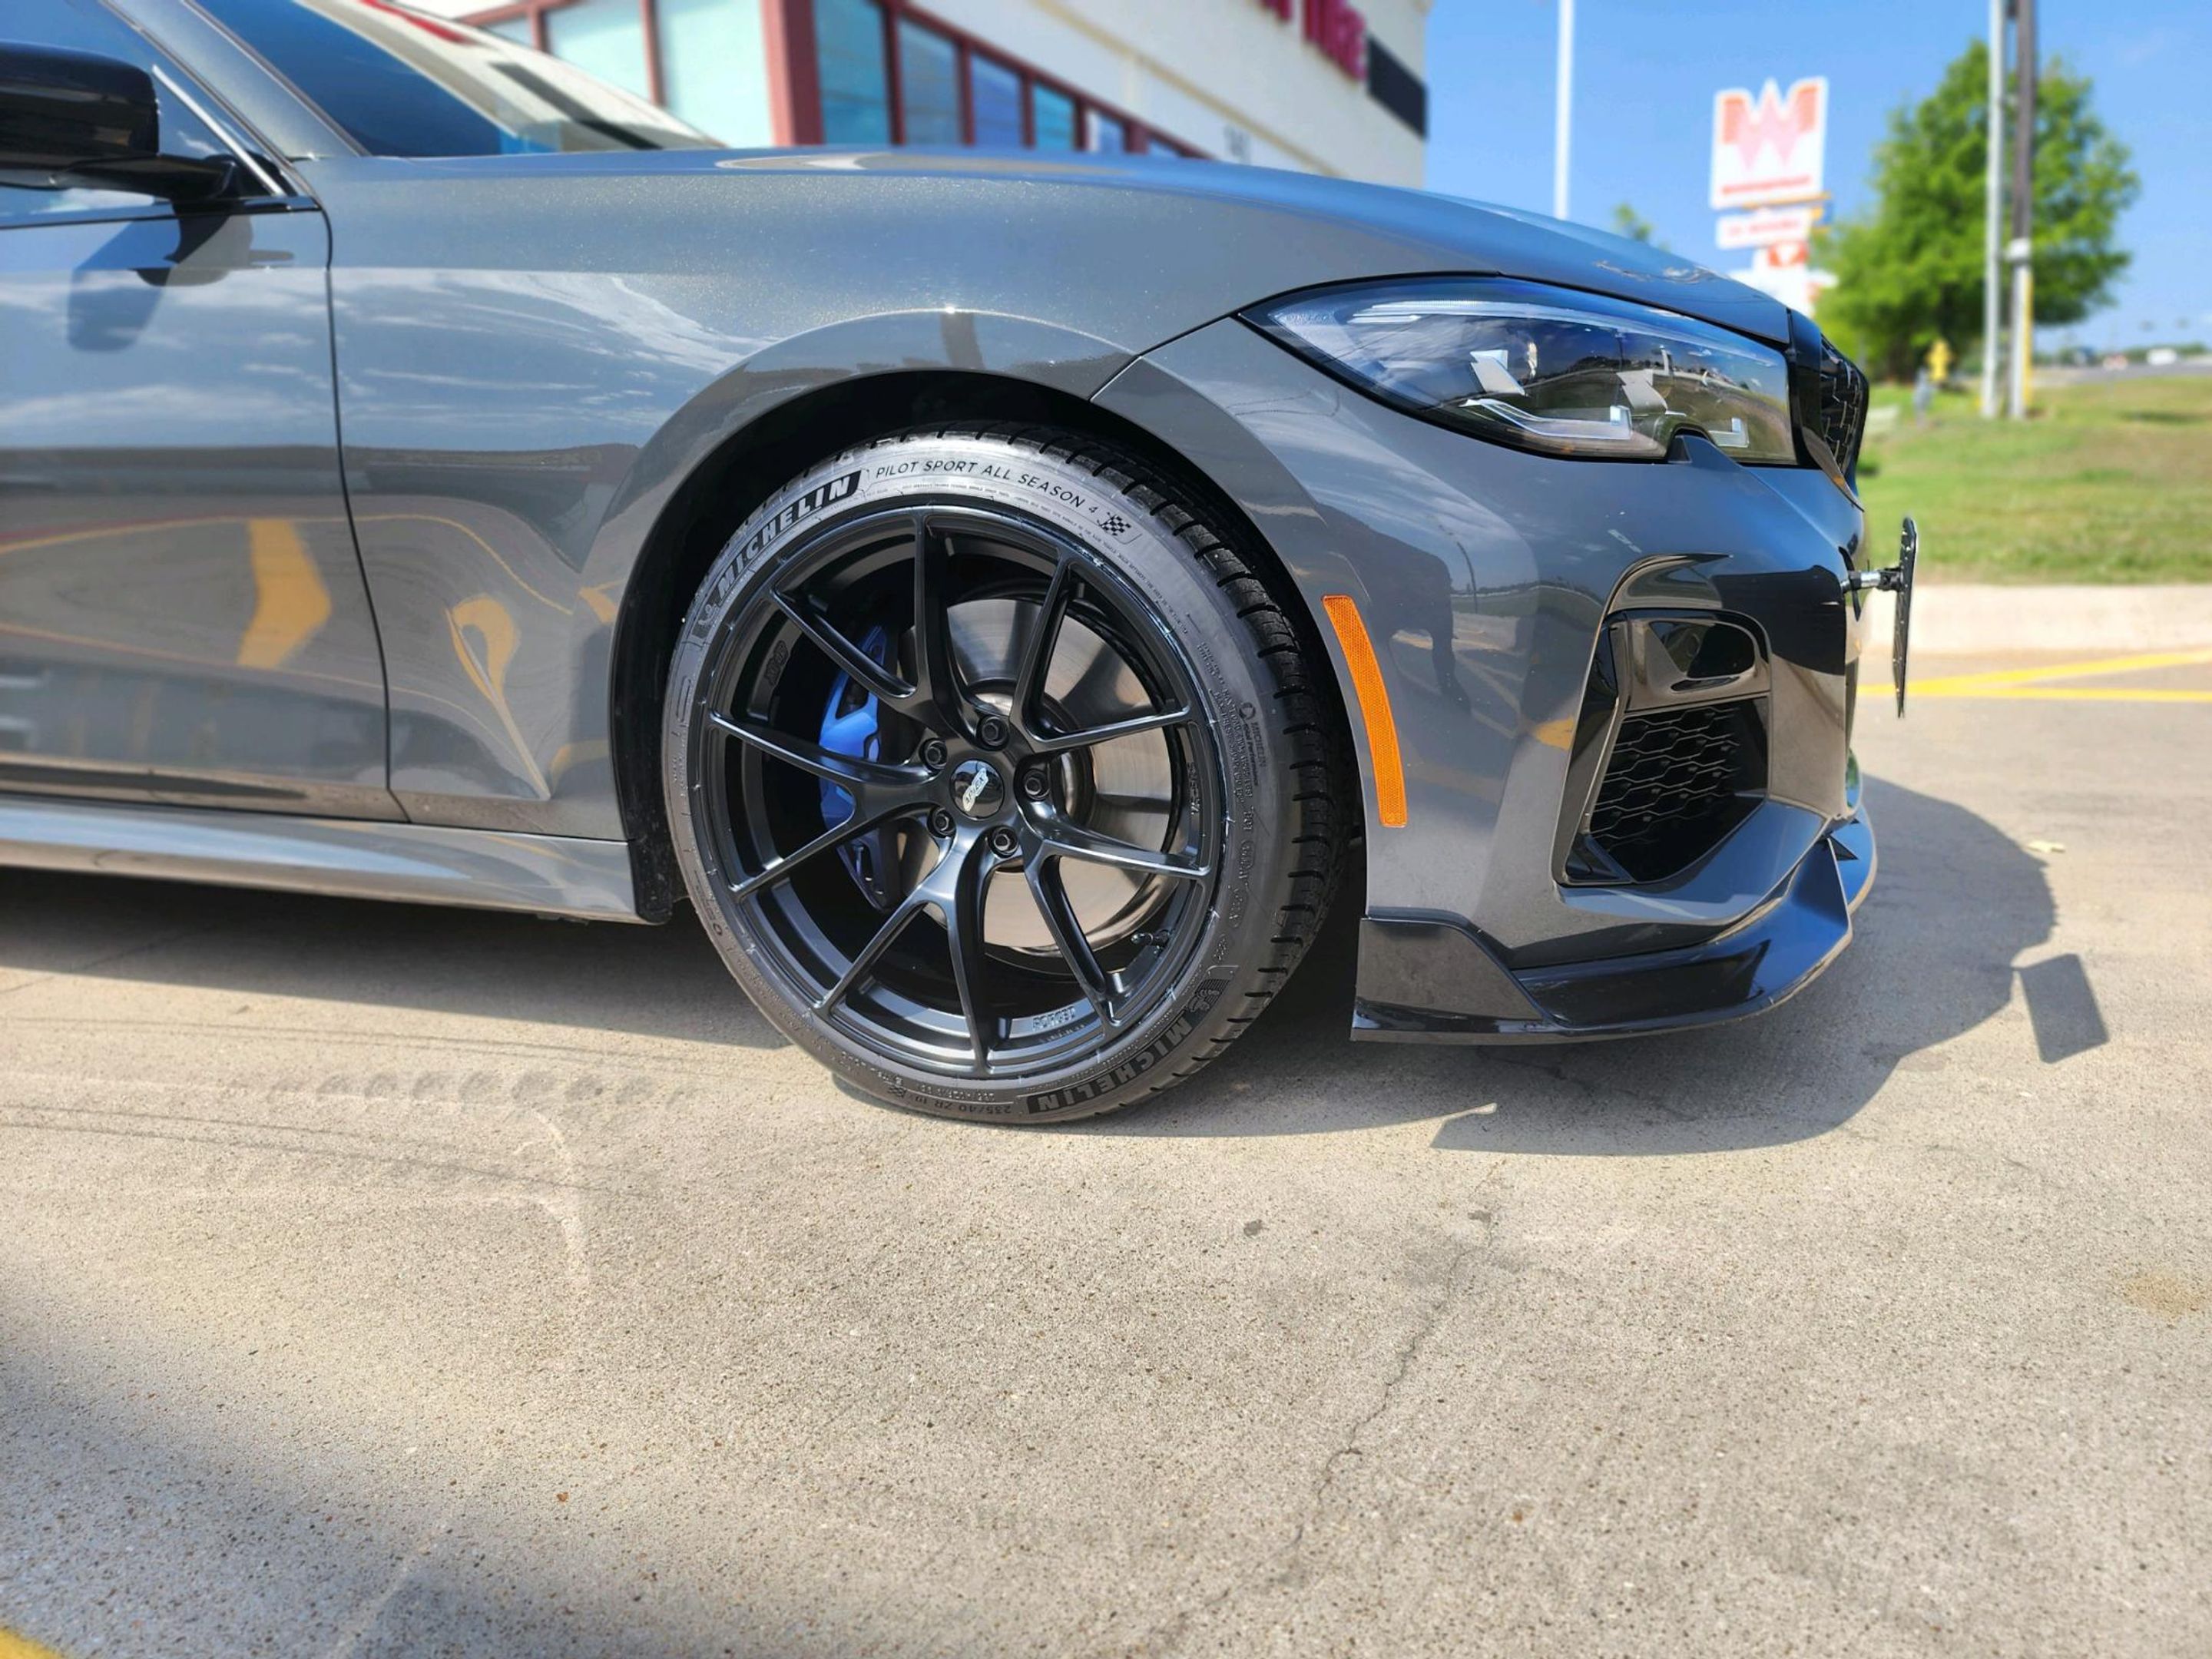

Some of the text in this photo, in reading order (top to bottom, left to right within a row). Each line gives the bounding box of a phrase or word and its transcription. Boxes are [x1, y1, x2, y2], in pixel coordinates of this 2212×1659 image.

[876, 461, 919, 478] PILOT
[923, 460, 979, 473] SPORT
[981, 465, 1012, 481] ALL
[1018, 473, 1085, 508] SEASON
[717, 475, 851, 598] MICHELIN
[1038, 1015, 1193, 1111] MICHELIN
